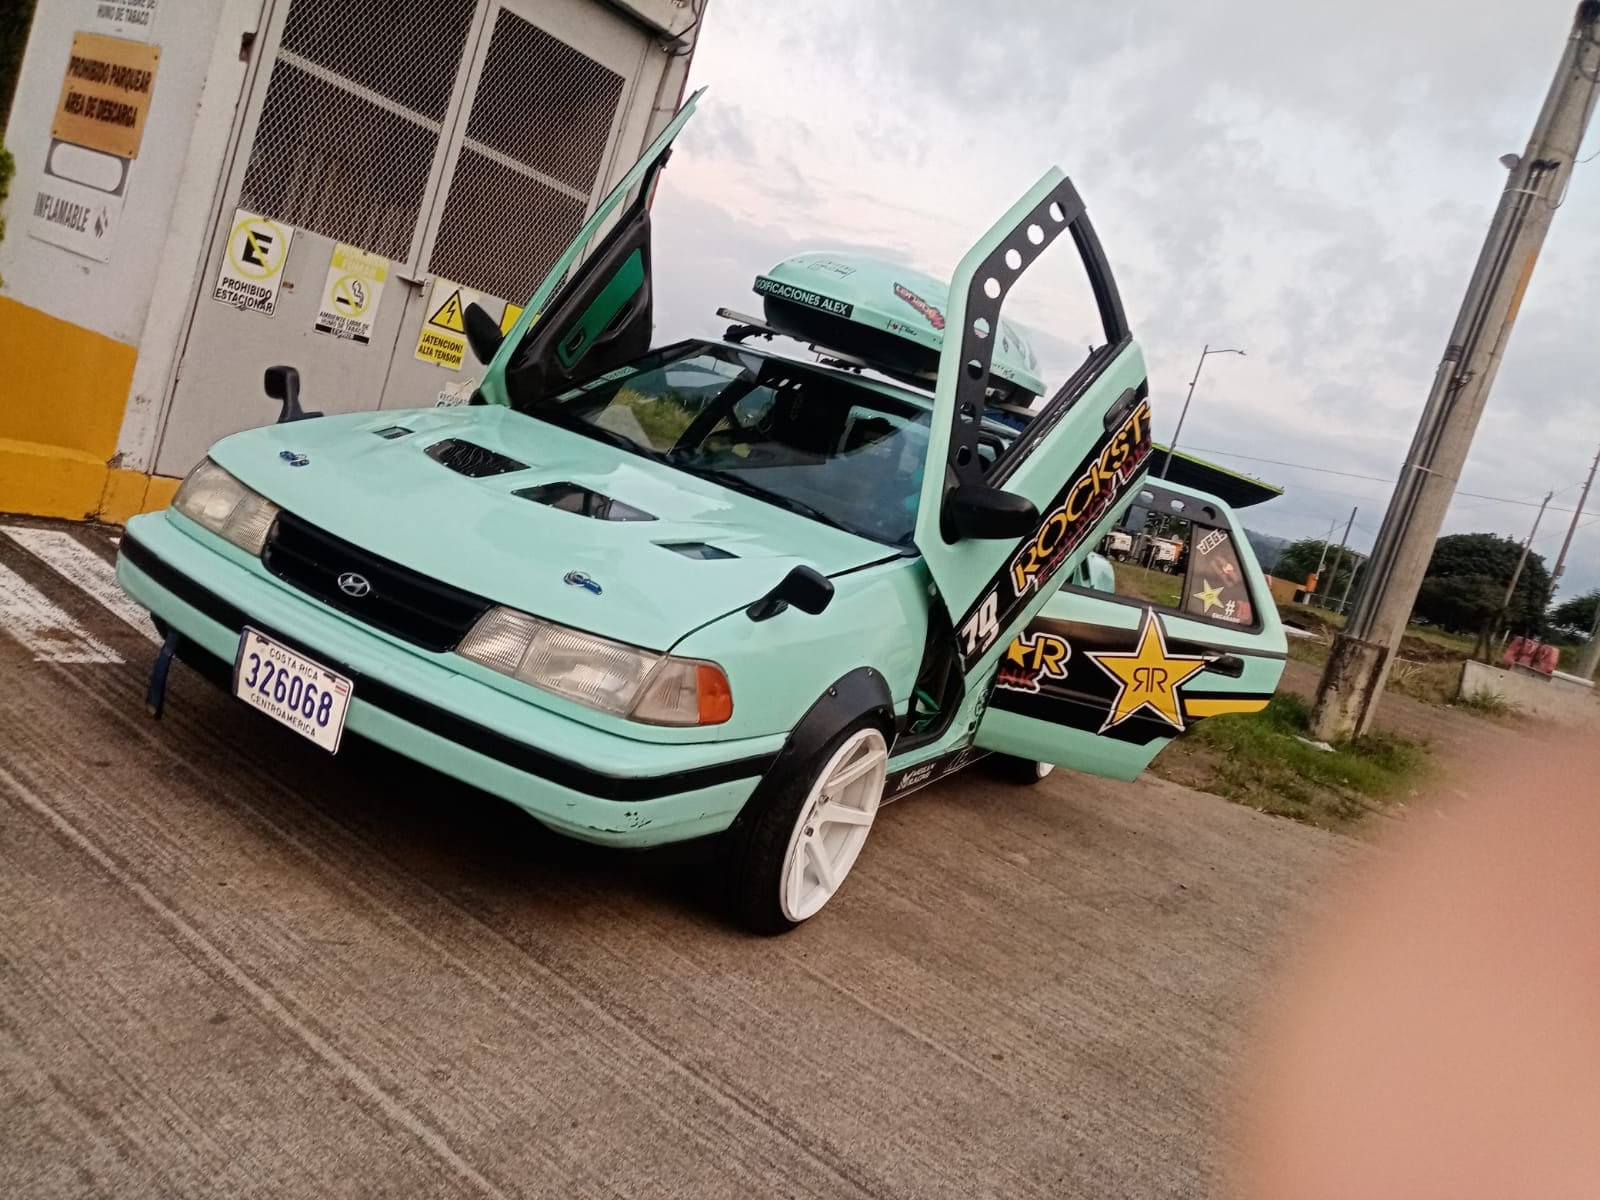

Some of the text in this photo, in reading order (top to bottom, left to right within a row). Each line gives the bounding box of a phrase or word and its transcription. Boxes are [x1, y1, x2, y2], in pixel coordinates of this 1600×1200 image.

[66, 55, 152, 94] PROHIBIDO PARQUEAR
[83, 95, 99, 119] DE
[95, 98, 138, 129] DESCARGA
[33, 191, 91, 233] INFLAMABLE
[215, 287, 273, 313] ESTACIONAR
[221, 276, 273, 299] PROHIBIDO
[756, 279, 848, 316] ODIFICACIONES ALEX
[418, 344, 462, 364] ALTA TENSION
[268, 647, 319, 681] COSTA RICA
[244, 652, 334, 728] 326068
[249, 692, 317, 737] CENTROAMERICA
